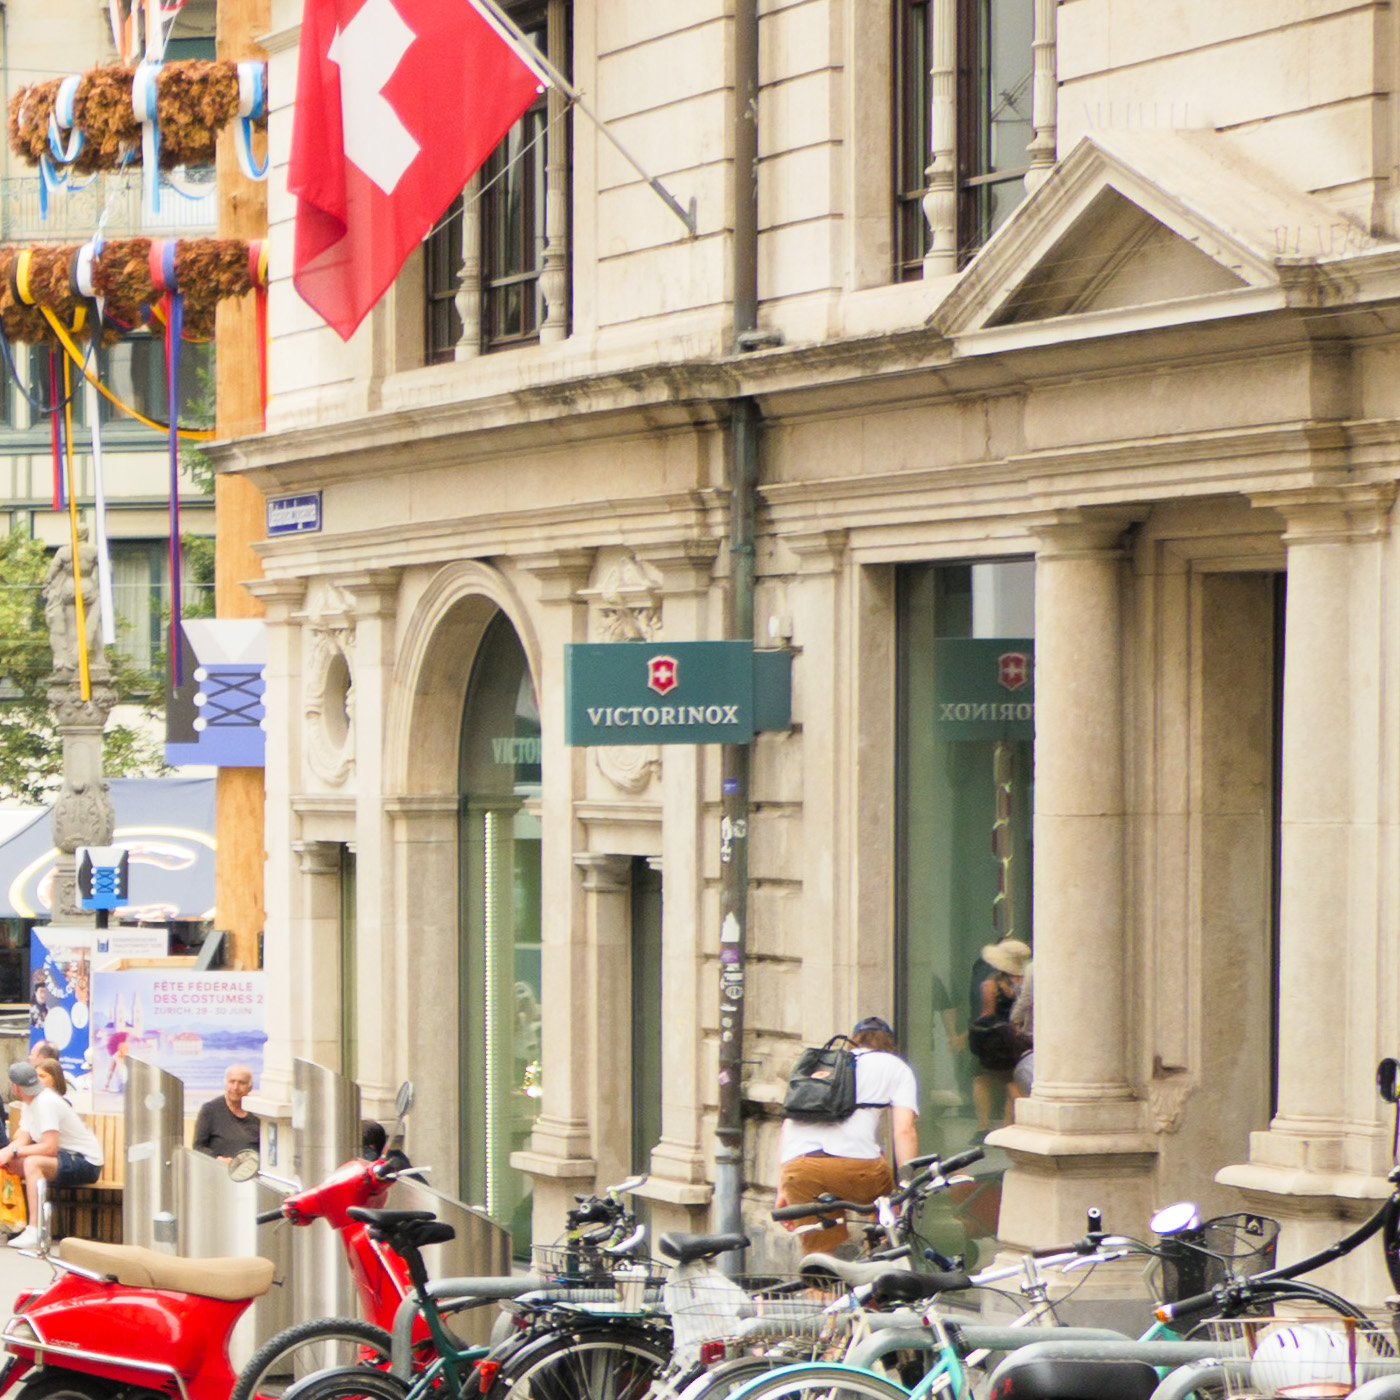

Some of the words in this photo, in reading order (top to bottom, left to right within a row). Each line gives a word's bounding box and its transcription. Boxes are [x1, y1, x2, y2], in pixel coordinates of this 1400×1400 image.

[587, 705, 739, 726] VICTORINOX
[153, 980, 184, 992] FÊTE
[188, 980, 253, 992] FÉDÉRALE
[153, 994, 178, 1004] DES
[181, 994, 253, 1004] COSTUMES
